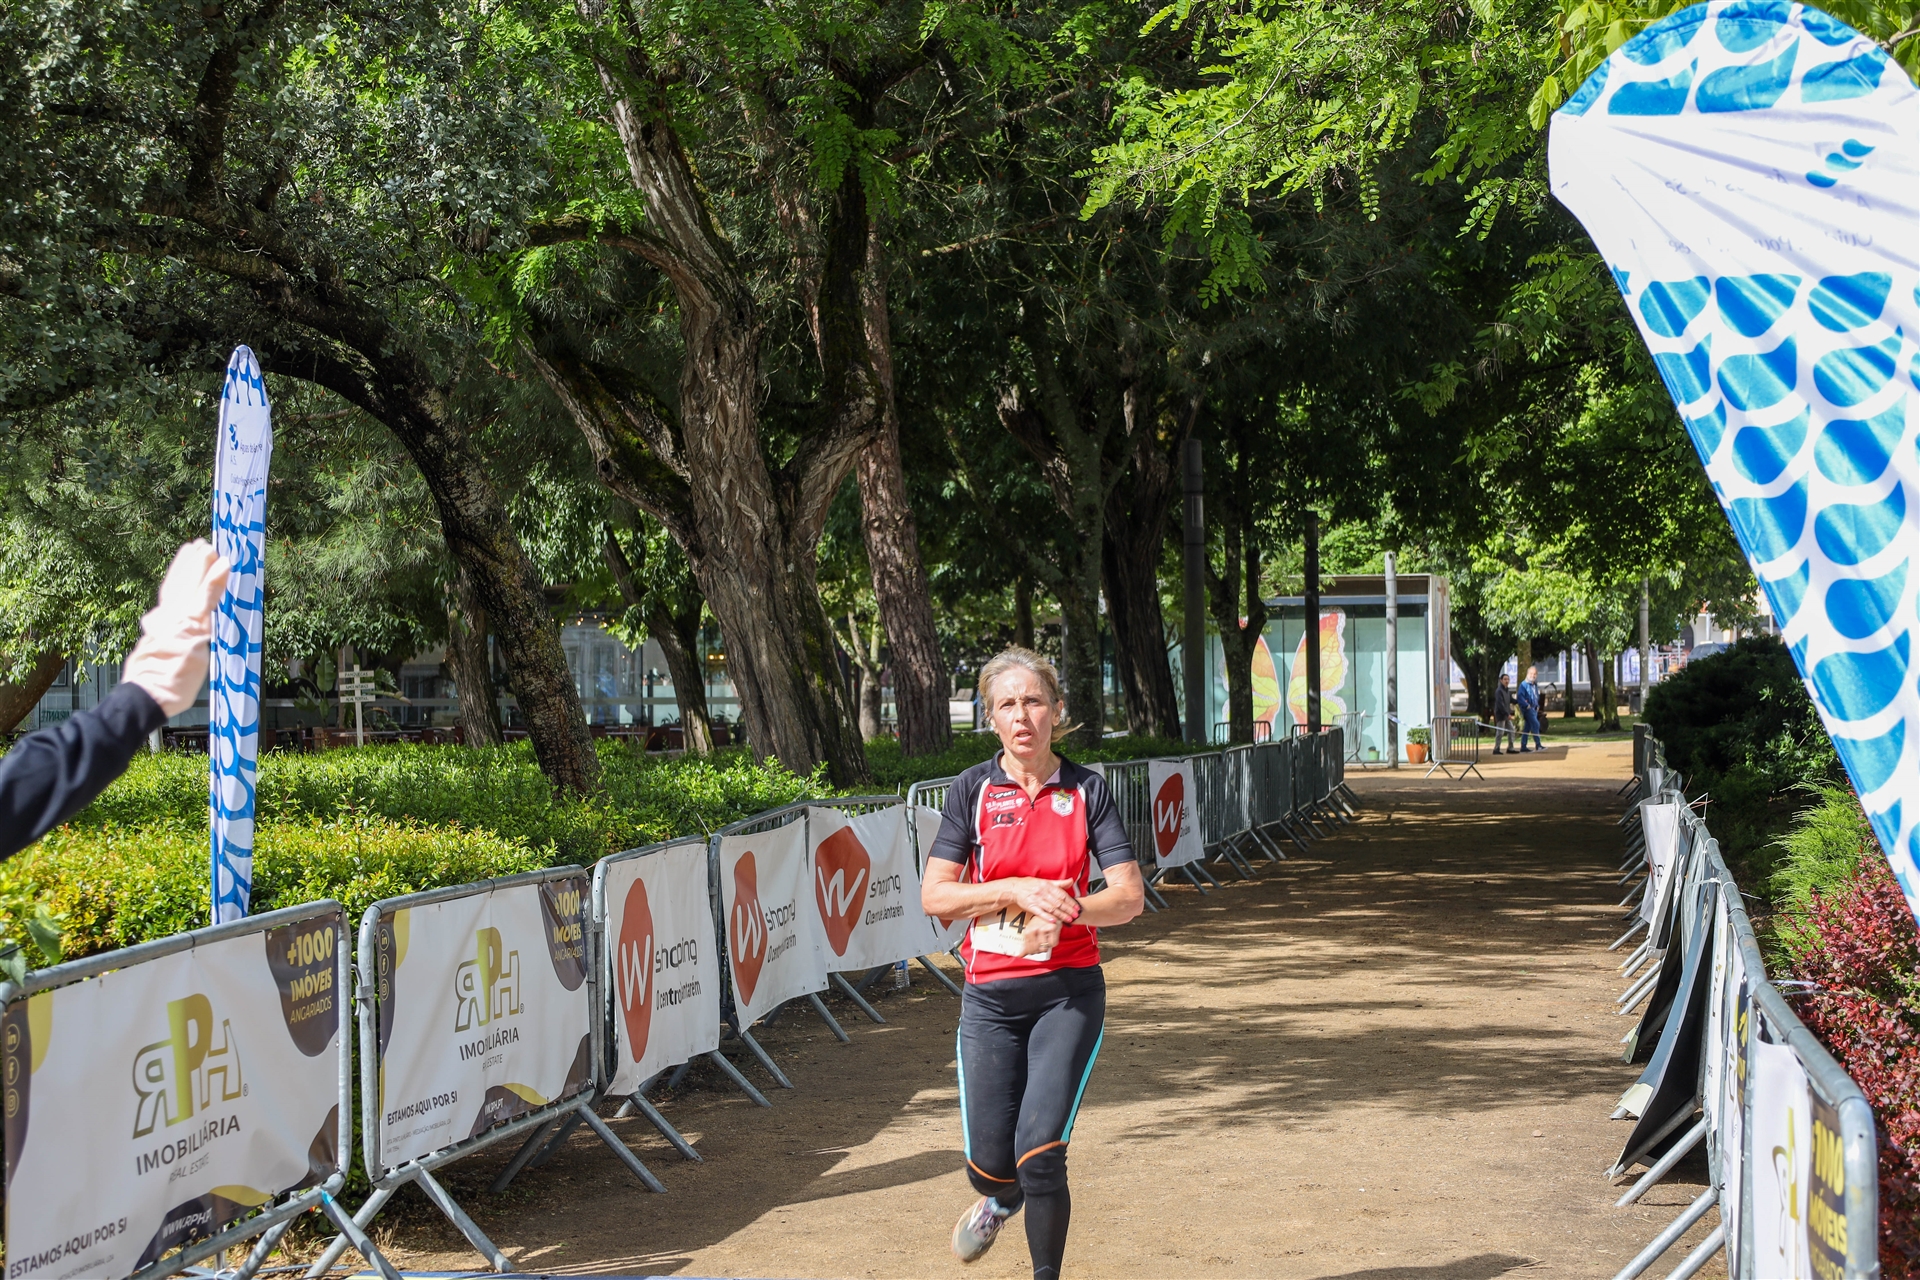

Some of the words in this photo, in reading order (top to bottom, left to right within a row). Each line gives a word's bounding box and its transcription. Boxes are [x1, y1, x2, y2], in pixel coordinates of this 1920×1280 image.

[996, 906, 1035, 934] 14
[287, 926, 334, 967] +1000
[290, 967, 333, 1002] IMÓVEIS
[290, 995, 332, 1024] ANGARIADOS
[387, 1105, 414, 1126] ESTAMOS
[415, 1099, 432, 1116] AQUI
[432, 1093, 451, 1110] POR
[451, 1090, 458, 1103] SI
[136, 1114, 241, 1176] IMOBILIÁRIA
[1809, 1188, 1847, 1257] MÓVEIS
[10, 1244, 62, 1279] ESTAMOS
[63, 1233, 93, 1255] AQUI
[94, 1224, 116, 1245] POR
[118, 1217, 128, 1235] SI
